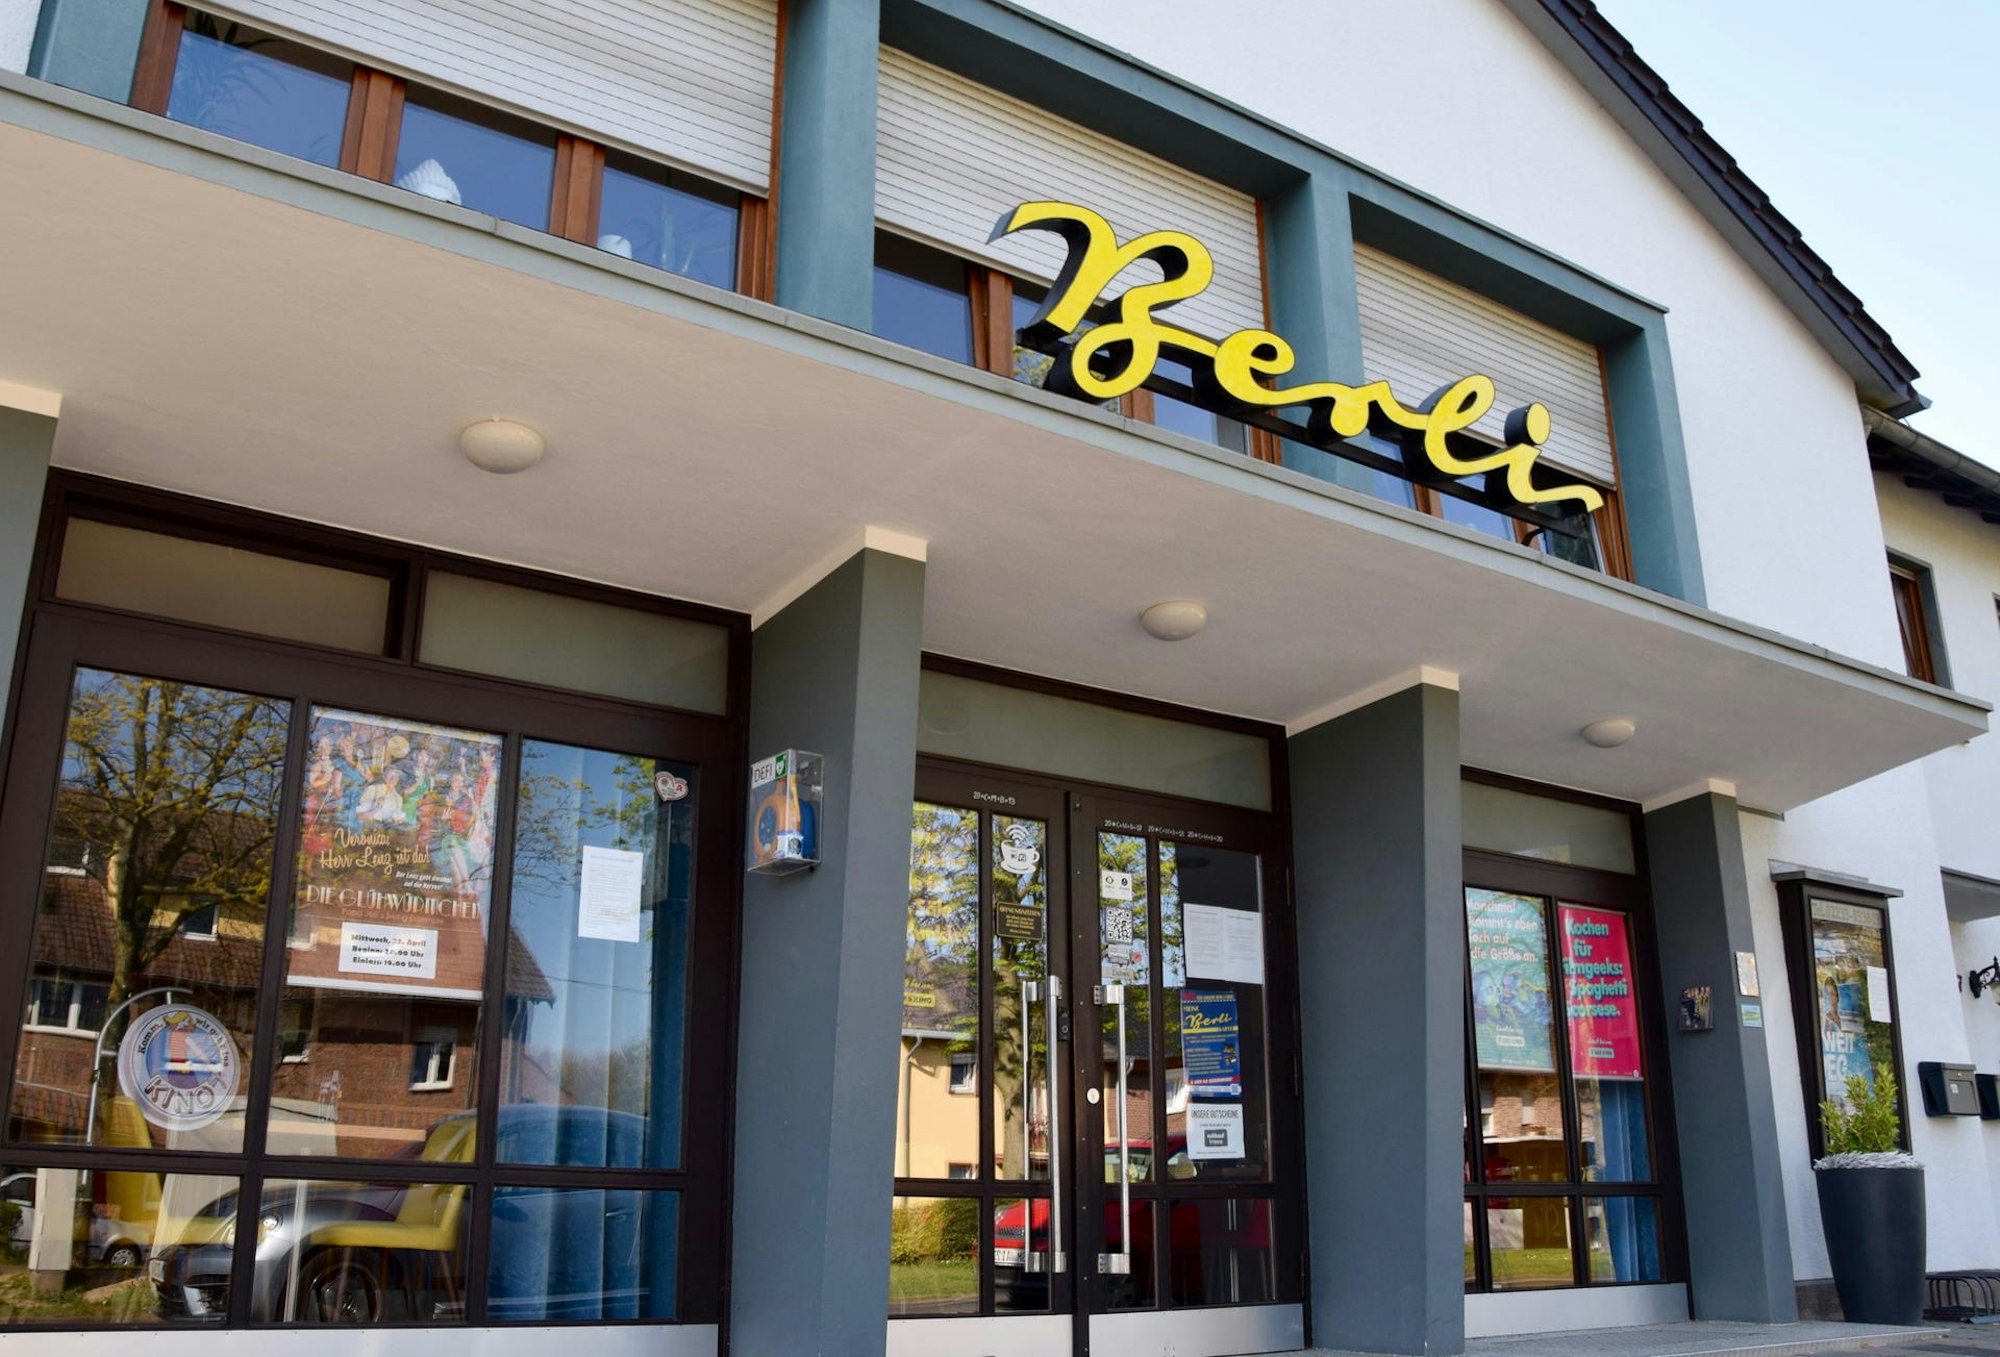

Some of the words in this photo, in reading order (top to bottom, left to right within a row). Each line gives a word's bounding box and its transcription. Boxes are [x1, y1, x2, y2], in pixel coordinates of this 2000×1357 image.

[1003, 200, 1604, 513] Berli
[754, 763, 773, 783] DEFI
[320, 849, 353, 869] Herr
[355, 846, 393, 875] Lenz
[396, 848, 411, 865] ist
[306, 884, 335, 906] DIE
[1565, 917, 1609, 937] Kochen
[351, 933, 391, 945] Mittwoch,
[406, 938, 427, 948] April
[1492, 931, 1509, 945] auf
[1574, 938, 1593, 958] für
[383, 959, 406, 968] 19.00
[408, 960, 422, 969] Uhr
[410, 949, 425, 959] Uhr
[1569, 978, 1628, 1000] Spaghetti
